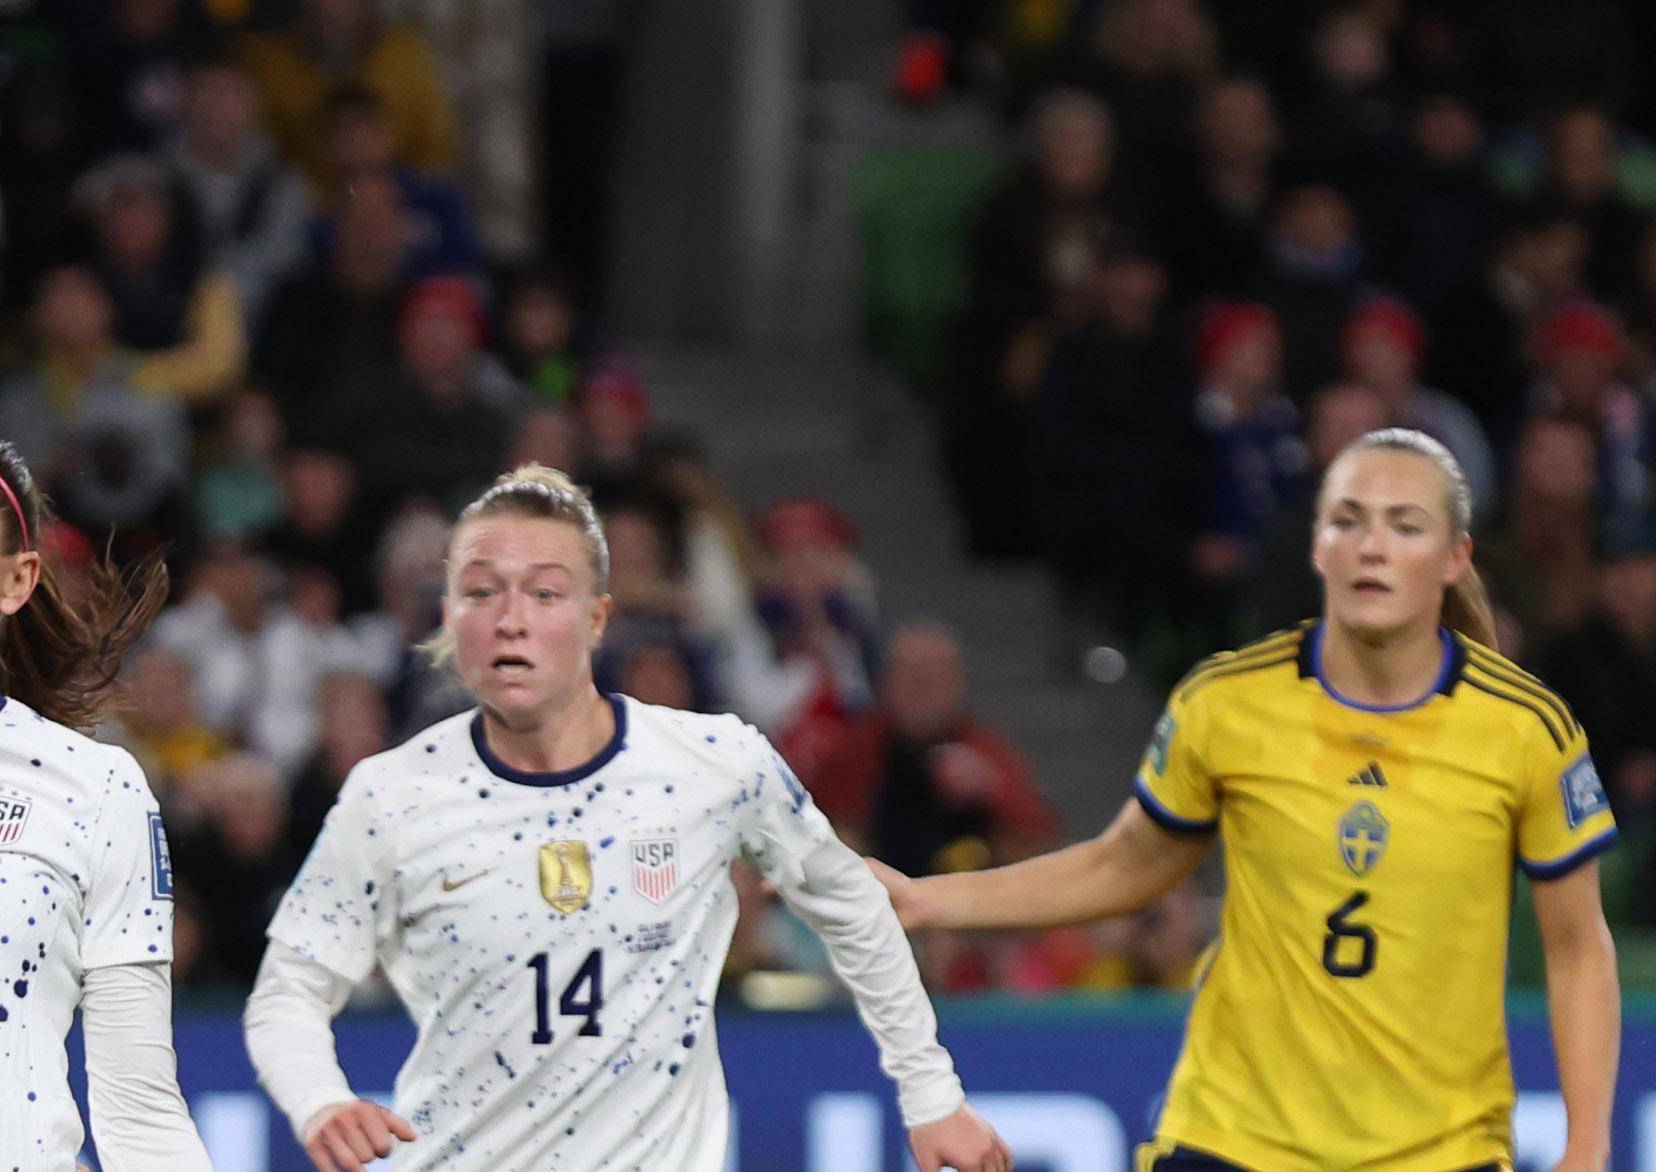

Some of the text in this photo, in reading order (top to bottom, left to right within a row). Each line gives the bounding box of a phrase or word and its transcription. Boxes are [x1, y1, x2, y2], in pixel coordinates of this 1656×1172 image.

[635, 843, 674, 867] USA
[1323, 890, 1378, 977] 6
[526, 947, 605, 1045] 14
